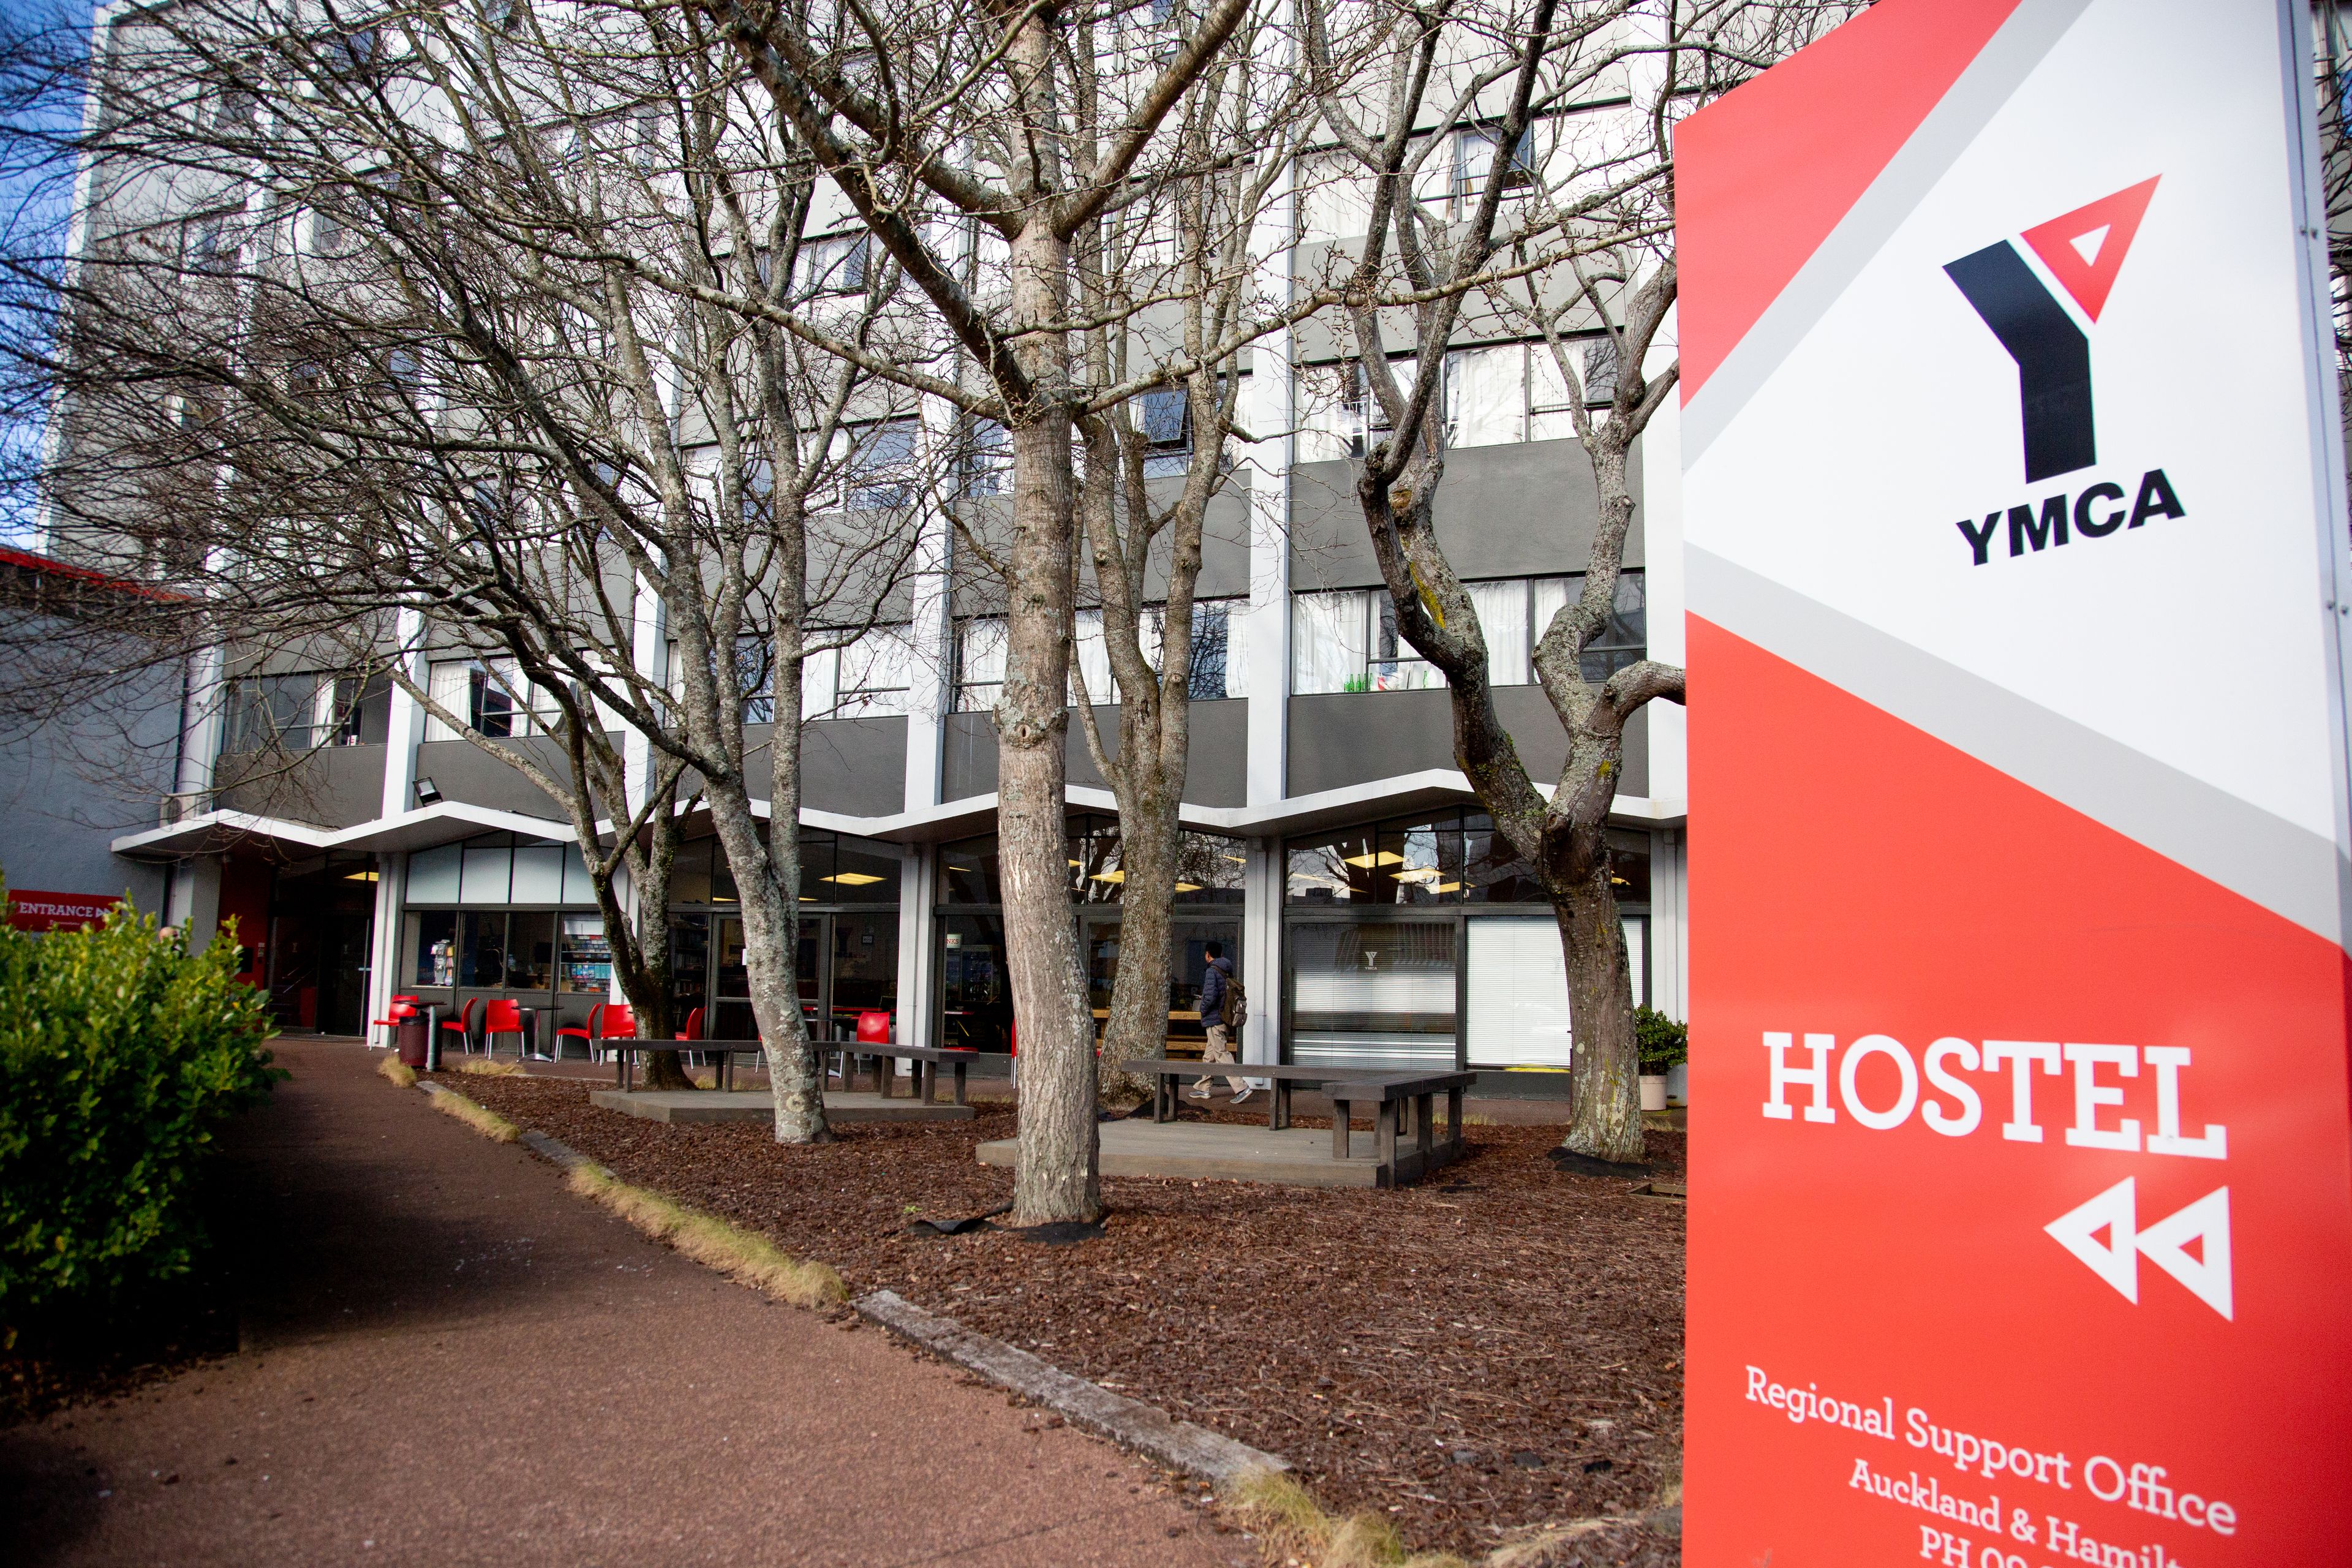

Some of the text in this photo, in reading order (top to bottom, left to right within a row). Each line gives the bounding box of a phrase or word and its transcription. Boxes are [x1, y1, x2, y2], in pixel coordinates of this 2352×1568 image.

[1956, 468, 2187, 566] YMCA
[19, 902, 94, 918] ENTRANCE
[1763, 1031, 2227, 1160] HOSTEL
[1746, 1365, 2237, 1536] Regional Support Office
[1849, 1458, 2002, 1534] Auckland
[2010, 1508, 2037, 1544] &
[1920, 1525, 1970, 1568] PH
